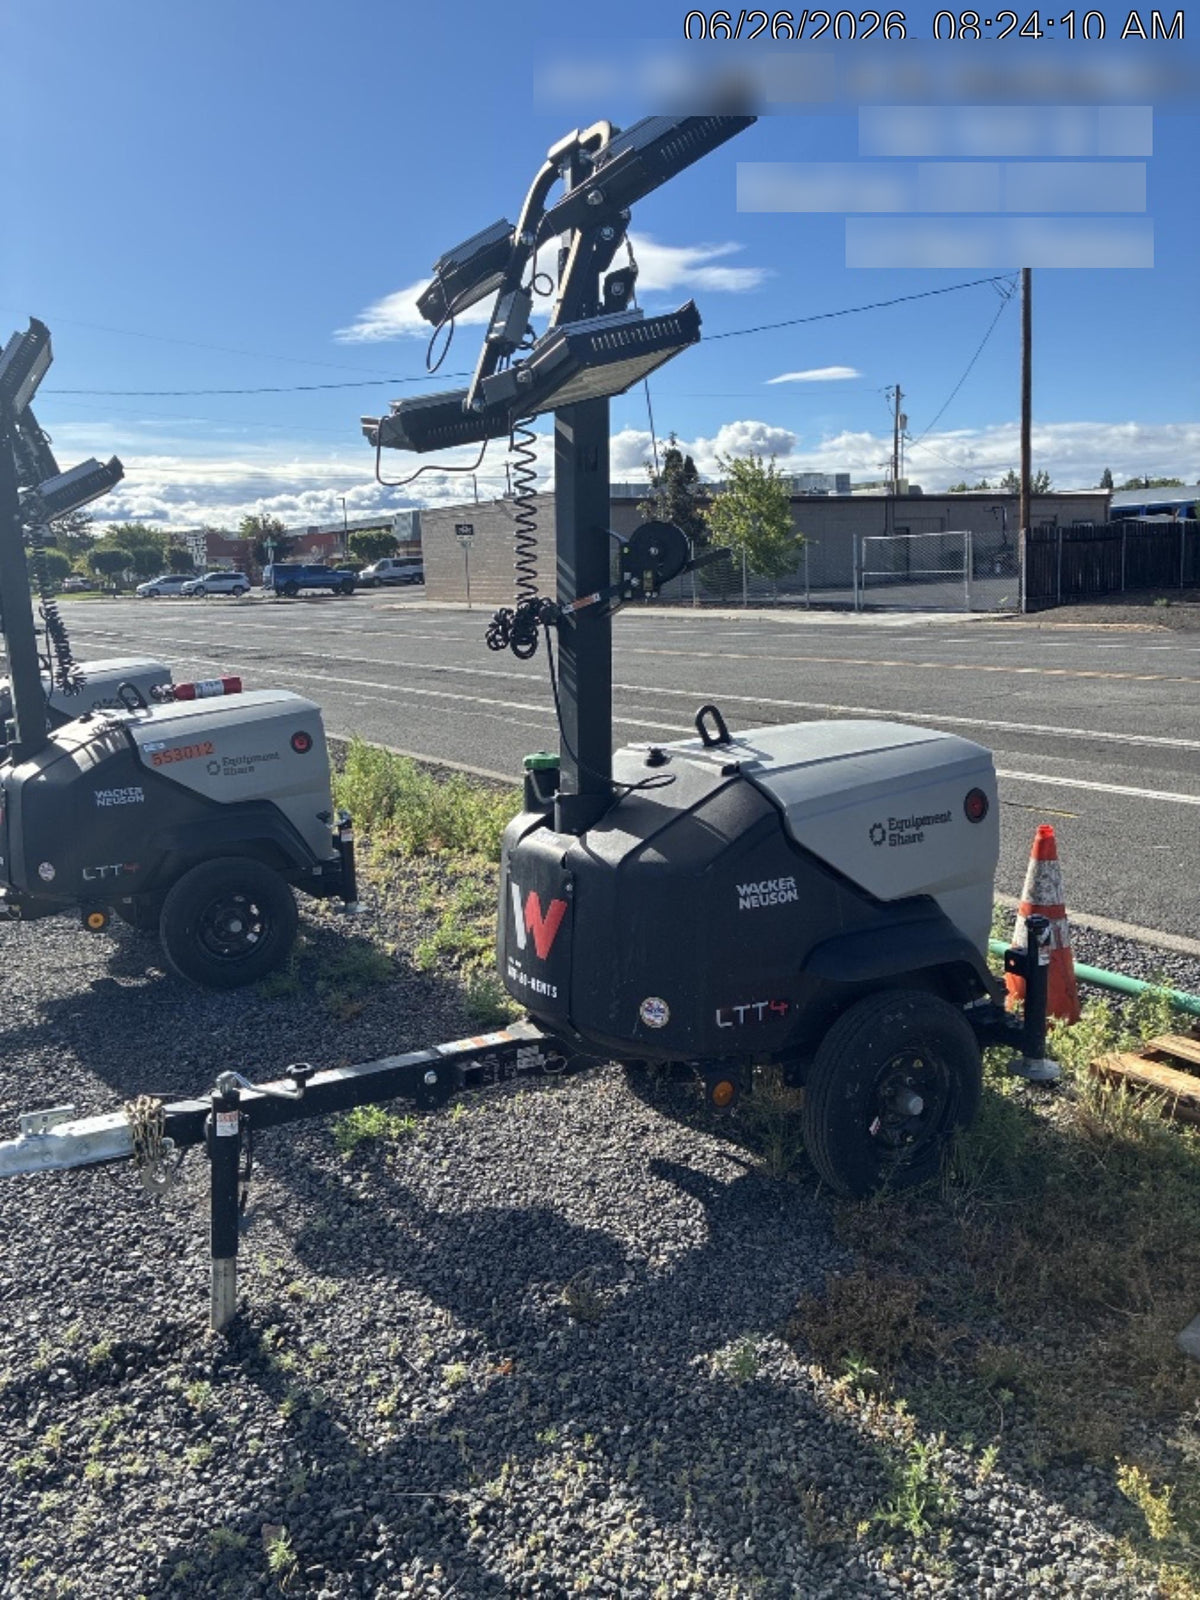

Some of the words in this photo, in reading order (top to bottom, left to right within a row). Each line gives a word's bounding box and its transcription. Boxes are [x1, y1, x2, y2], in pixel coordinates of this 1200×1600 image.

[152, 741, 214, 768] 553012
[222, 752, 280, 767] Equipment
[94, 786, 143, 799] WACKER
[96, 794, 145, 807] NEUSON
[888, 810, 952, 832] Equipment
[888, 831, 924, 847] Share
[736, 876, 797, 897] WACKER
[738, 888, 799, 909] NEUSON
[716, 1000, 788, 1028] LTT4
